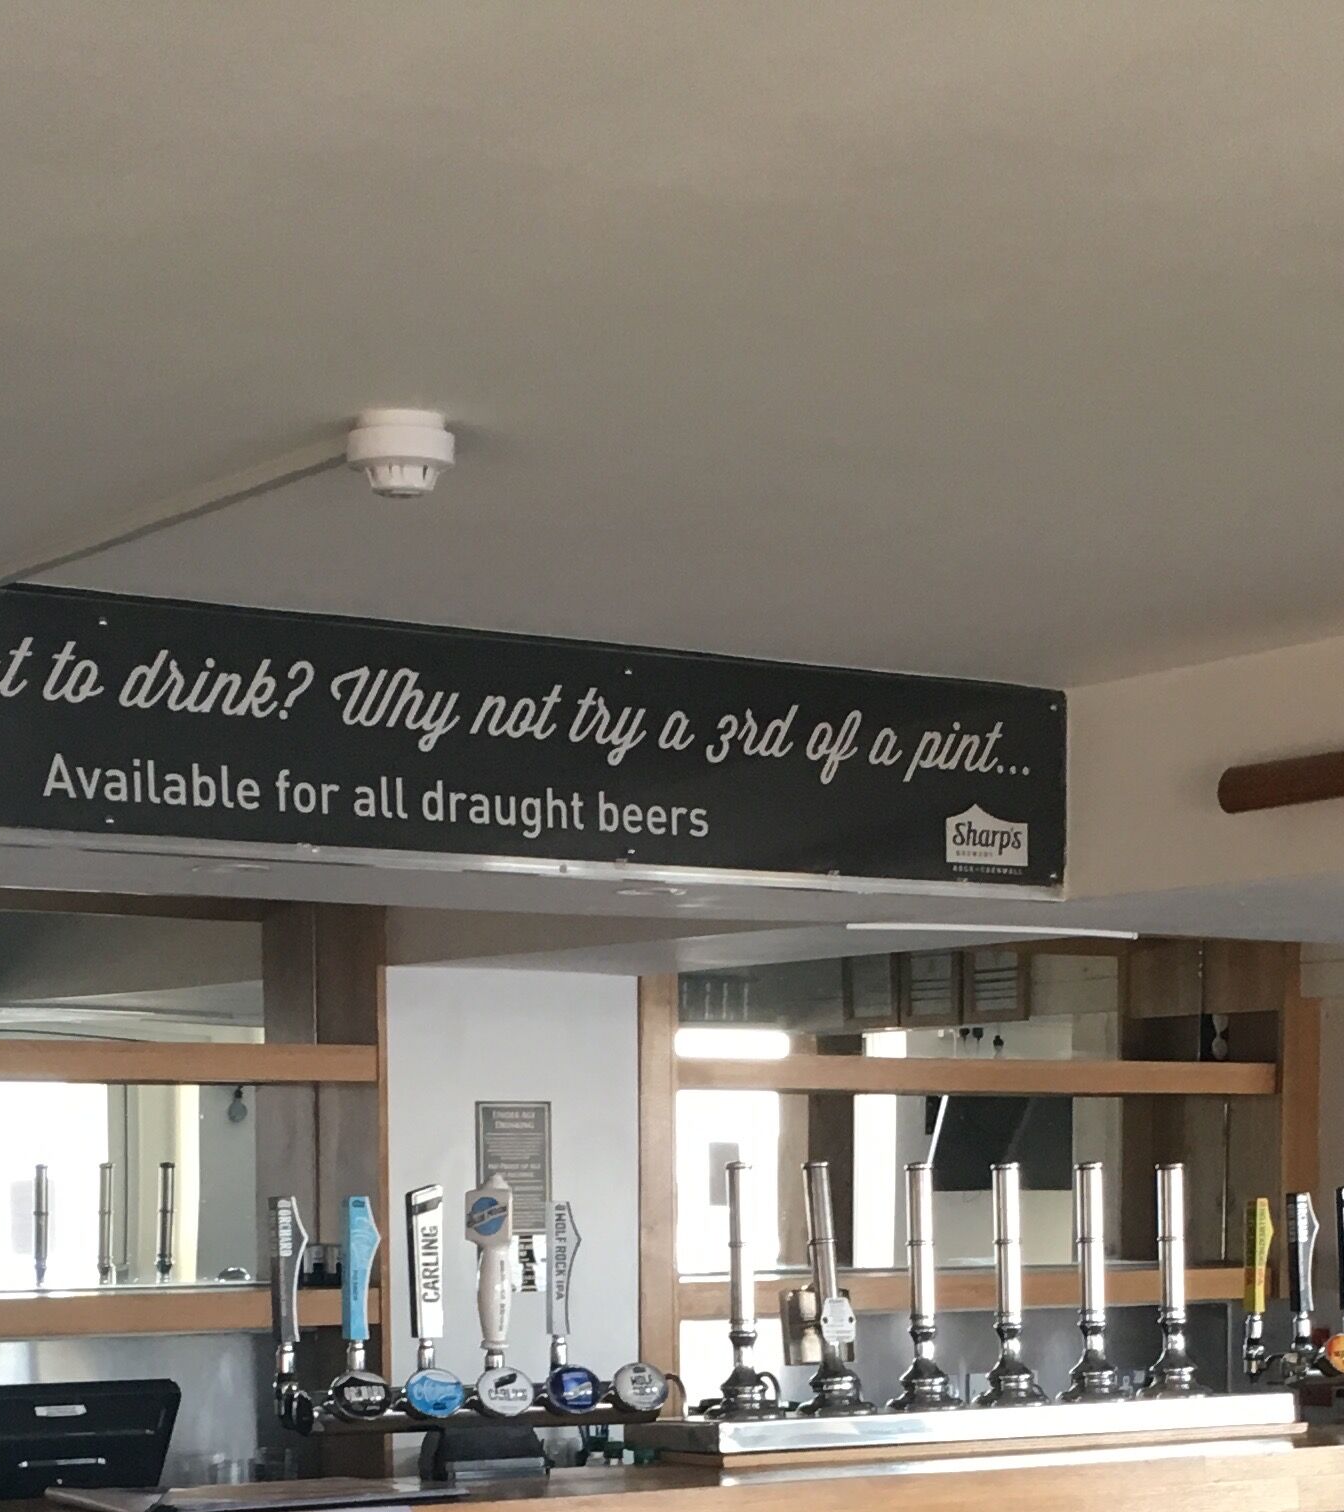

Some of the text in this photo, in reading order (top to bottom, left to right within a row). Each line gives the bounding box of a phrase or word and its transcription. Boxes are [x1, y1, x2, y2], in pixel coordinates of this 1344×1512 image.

[42, 641, 105, 704] to
[118, 649, 315, 721] drink?
[330, 665, 461, 753] Why
[469, 684, 563, 740] not
[568, 687, 647, 766] try
[658, 710, 695, 751] a
[705, 704, 799, 764] 3rd
[806, 710, 862, 785] of
[868, 727, 903, 766] a
[42, 753, 709, 839] Available for all draught beers
[952, 821, 1023, 856] Sharp's
[277, 1209, 293, 1257] ORCHARD
[420, 1225, 441, 1303] CARLING
[554, 1213, 567, 1301] WOLF ROCK IPA
